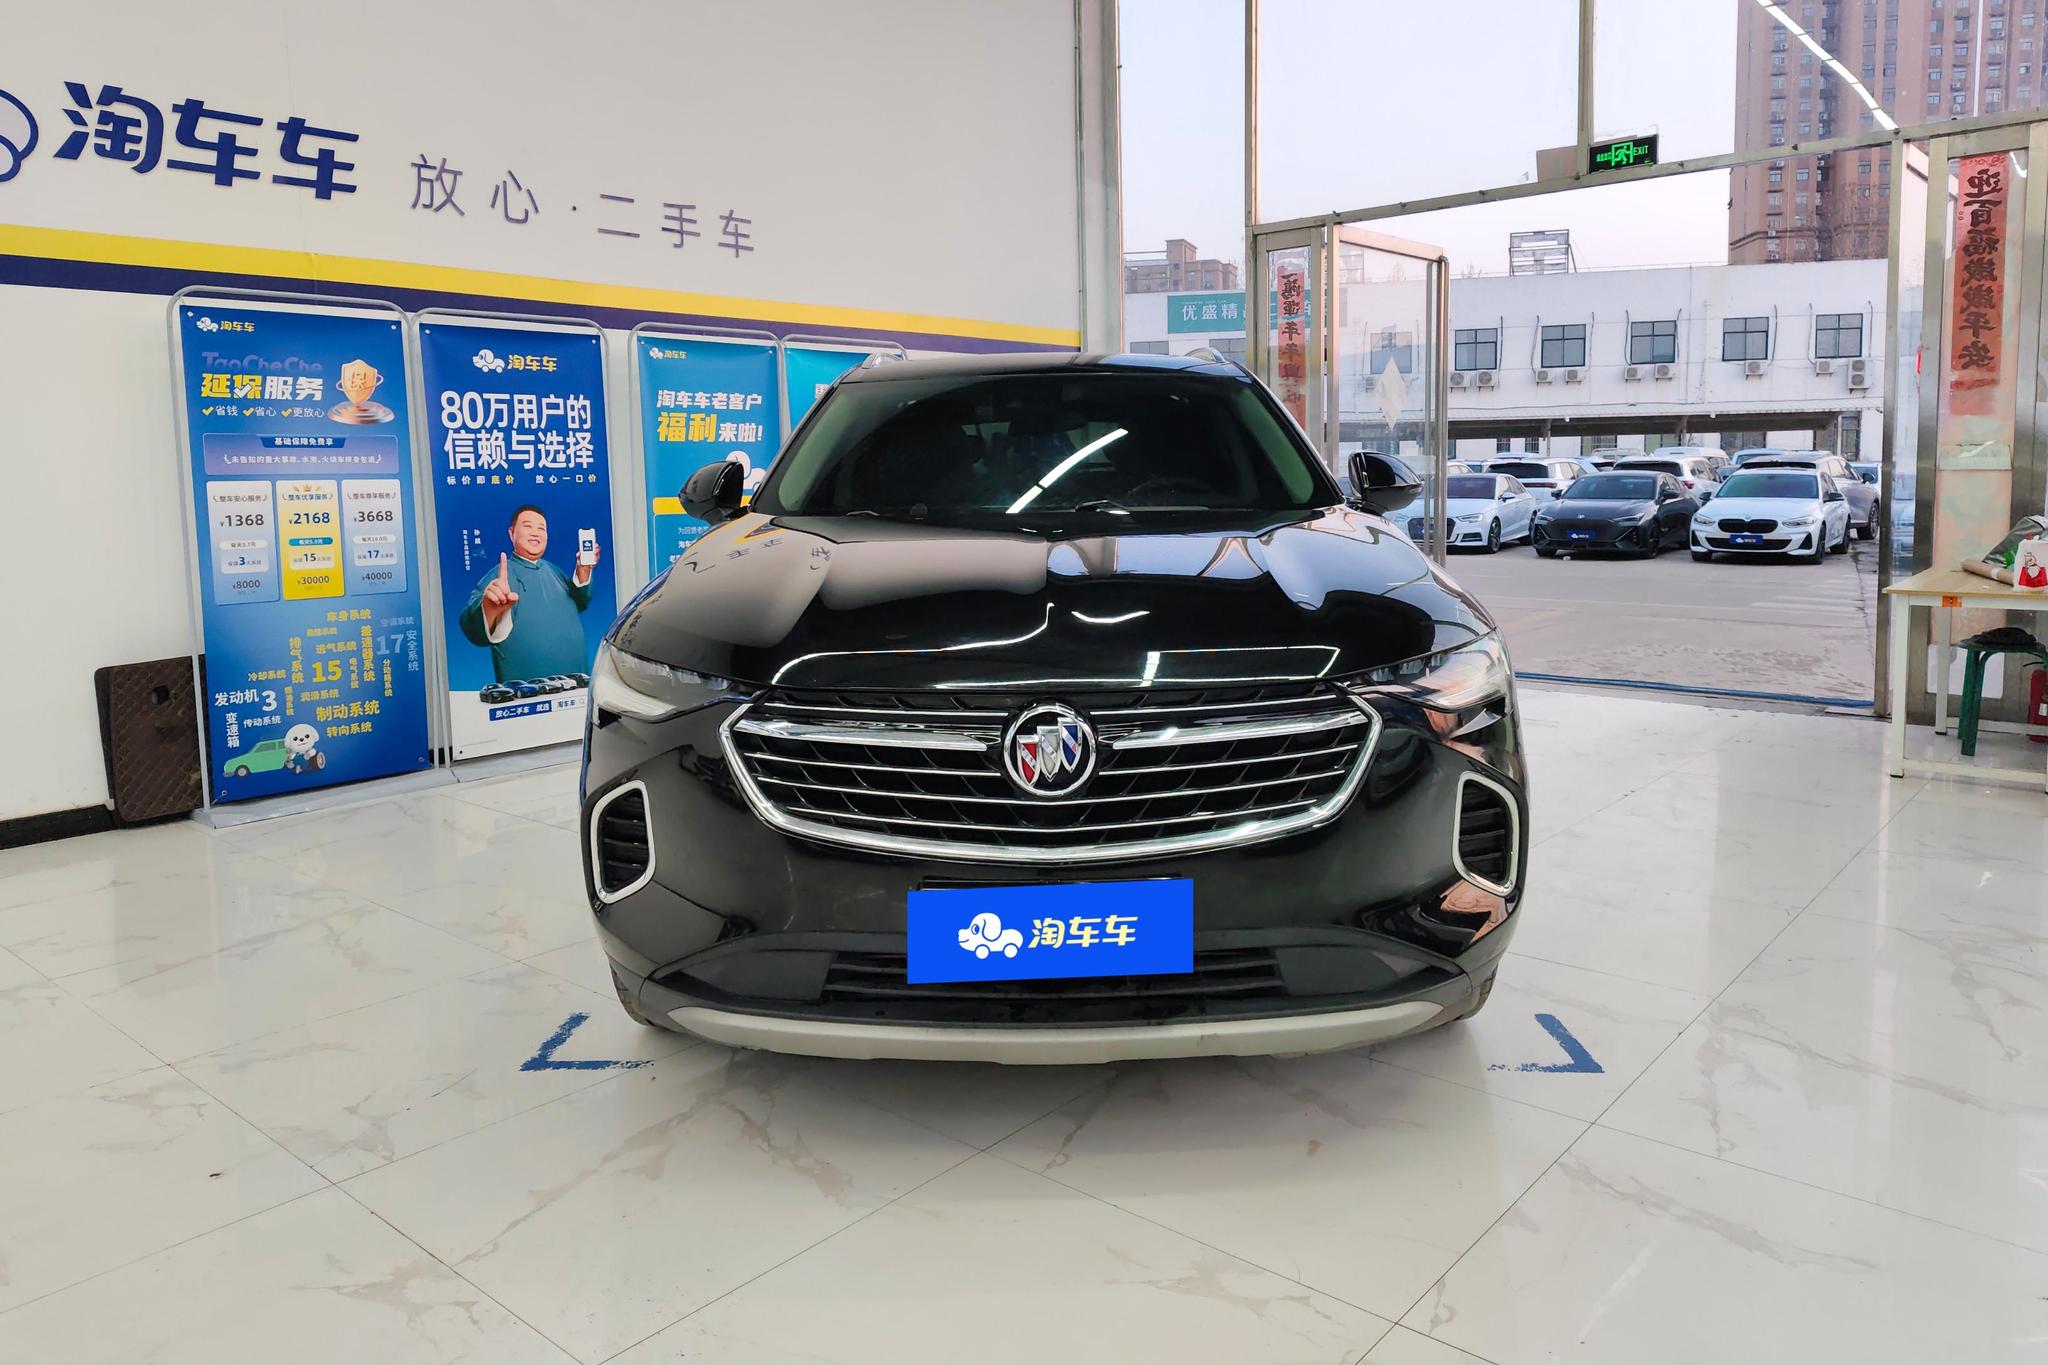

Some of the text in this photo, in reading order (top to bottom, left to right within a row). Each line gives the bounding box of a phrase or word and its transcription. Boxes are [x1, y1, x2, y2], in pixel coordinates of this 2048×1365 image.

[53, 81, 360, 200] 淘车车
[1633, 145, 1649, 156] EXIT
[219, 320, 256, 334] 淘车车
[201, 351, 323, 373] TaoCheChe
[507, 354, 558, 373] 淘车车
[200, 372, 324, 401] 延保服务
[656, 389, 763, 411] 淘车车老客户
[215, 405, 325, 418] 省钱 省心 更放心
[440, 390, 592, 430] 80万用户的
[443, 429, 595, 471] 信赖与选择
[535, 473, 597, 485] 放心一口价
[220, 513, 265, 527] ¥1368
[288, 511, 331, 525] ¥2168
[353, 510, 394, 523] ¥3668
[376, 633, 405, 656] 17
[406, 628, 420, 673] 安全系统
[247, 667, 288, 683] 冷却系统
[311, 659, 343, 683] 15
[214, 688, 260, 707] 发动机
[261, 689, 278, 712] 3
[315, 699, 381, 722] 制动系统
[495, 705, 530, 719] 放心二手车
[225, 711, 240, 749] 变速箱
[243, 714, 283, 729] 传动系统
[325, 720, 374, 738] 转向系统
